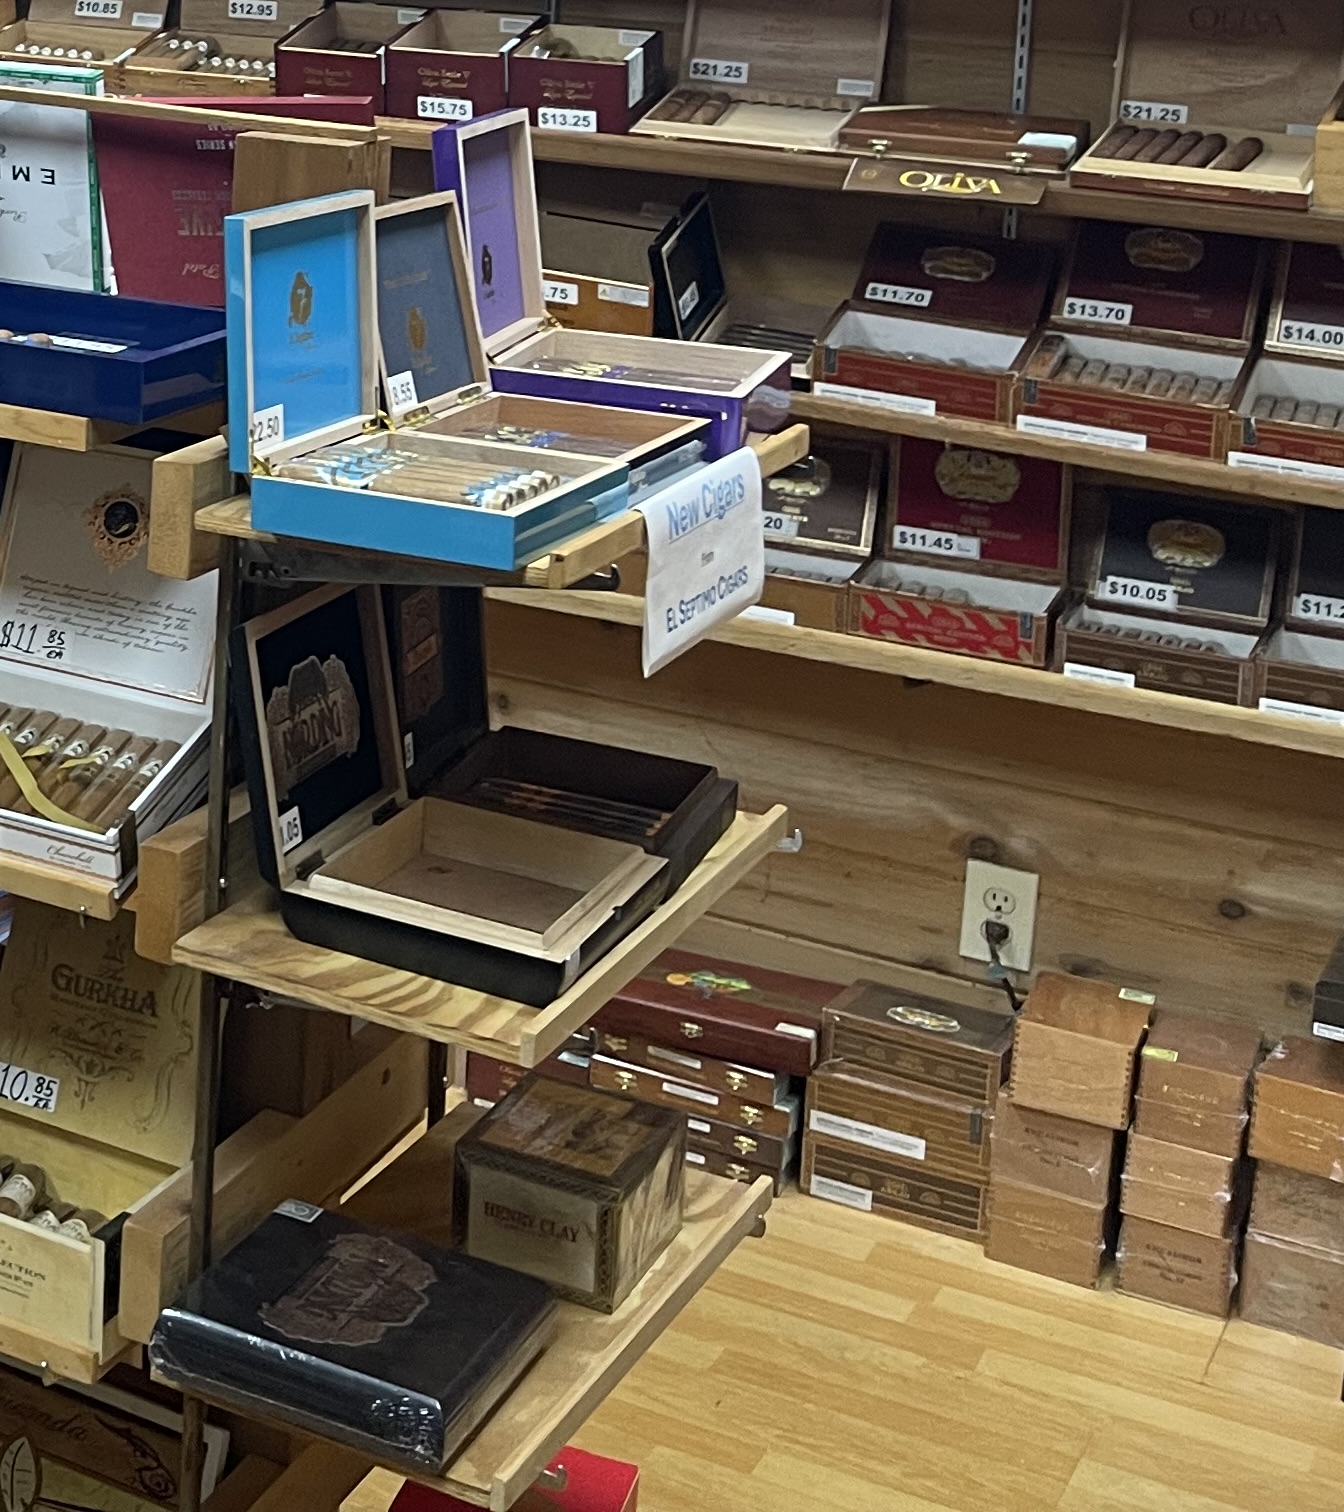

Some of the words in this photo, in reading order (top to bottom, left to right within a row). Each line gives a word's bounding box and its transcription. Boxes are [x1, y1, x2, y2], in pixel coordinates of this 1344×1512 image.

[77, 0, 117, 14] $10.85
[230, 2, 273, 17] $12.95
[692, 61, 743, 78] $21.25
[420, 101, 469, 117] $15.75
[1123, 104, 1182, 121] $21.25
[541, 112, 592, 128] $13.25
[900, 169, 1001, 196] OLIVA
[868, 285, 925, 304] $11.70
[1067, 302, 1125, 322] $13.70
[1283, 325, 1344, 347] $14.00
[667, 496, 701, 541] New
[700, 470, 746, 522] Cigars
[898, 531, 954, 552] $11.45
[666, 607, 678, 634] EL
[678, 584, 716, 627] SEPTIMO
[716, 565, 749, 604] CIGARS
[1108, 582, 1168, 604] $10.05
[50, 962, 160, 1019] GURKHA
[483, 1200, 537, 1234] HENRY
[540, 1217, 581, 1245] CLAY
